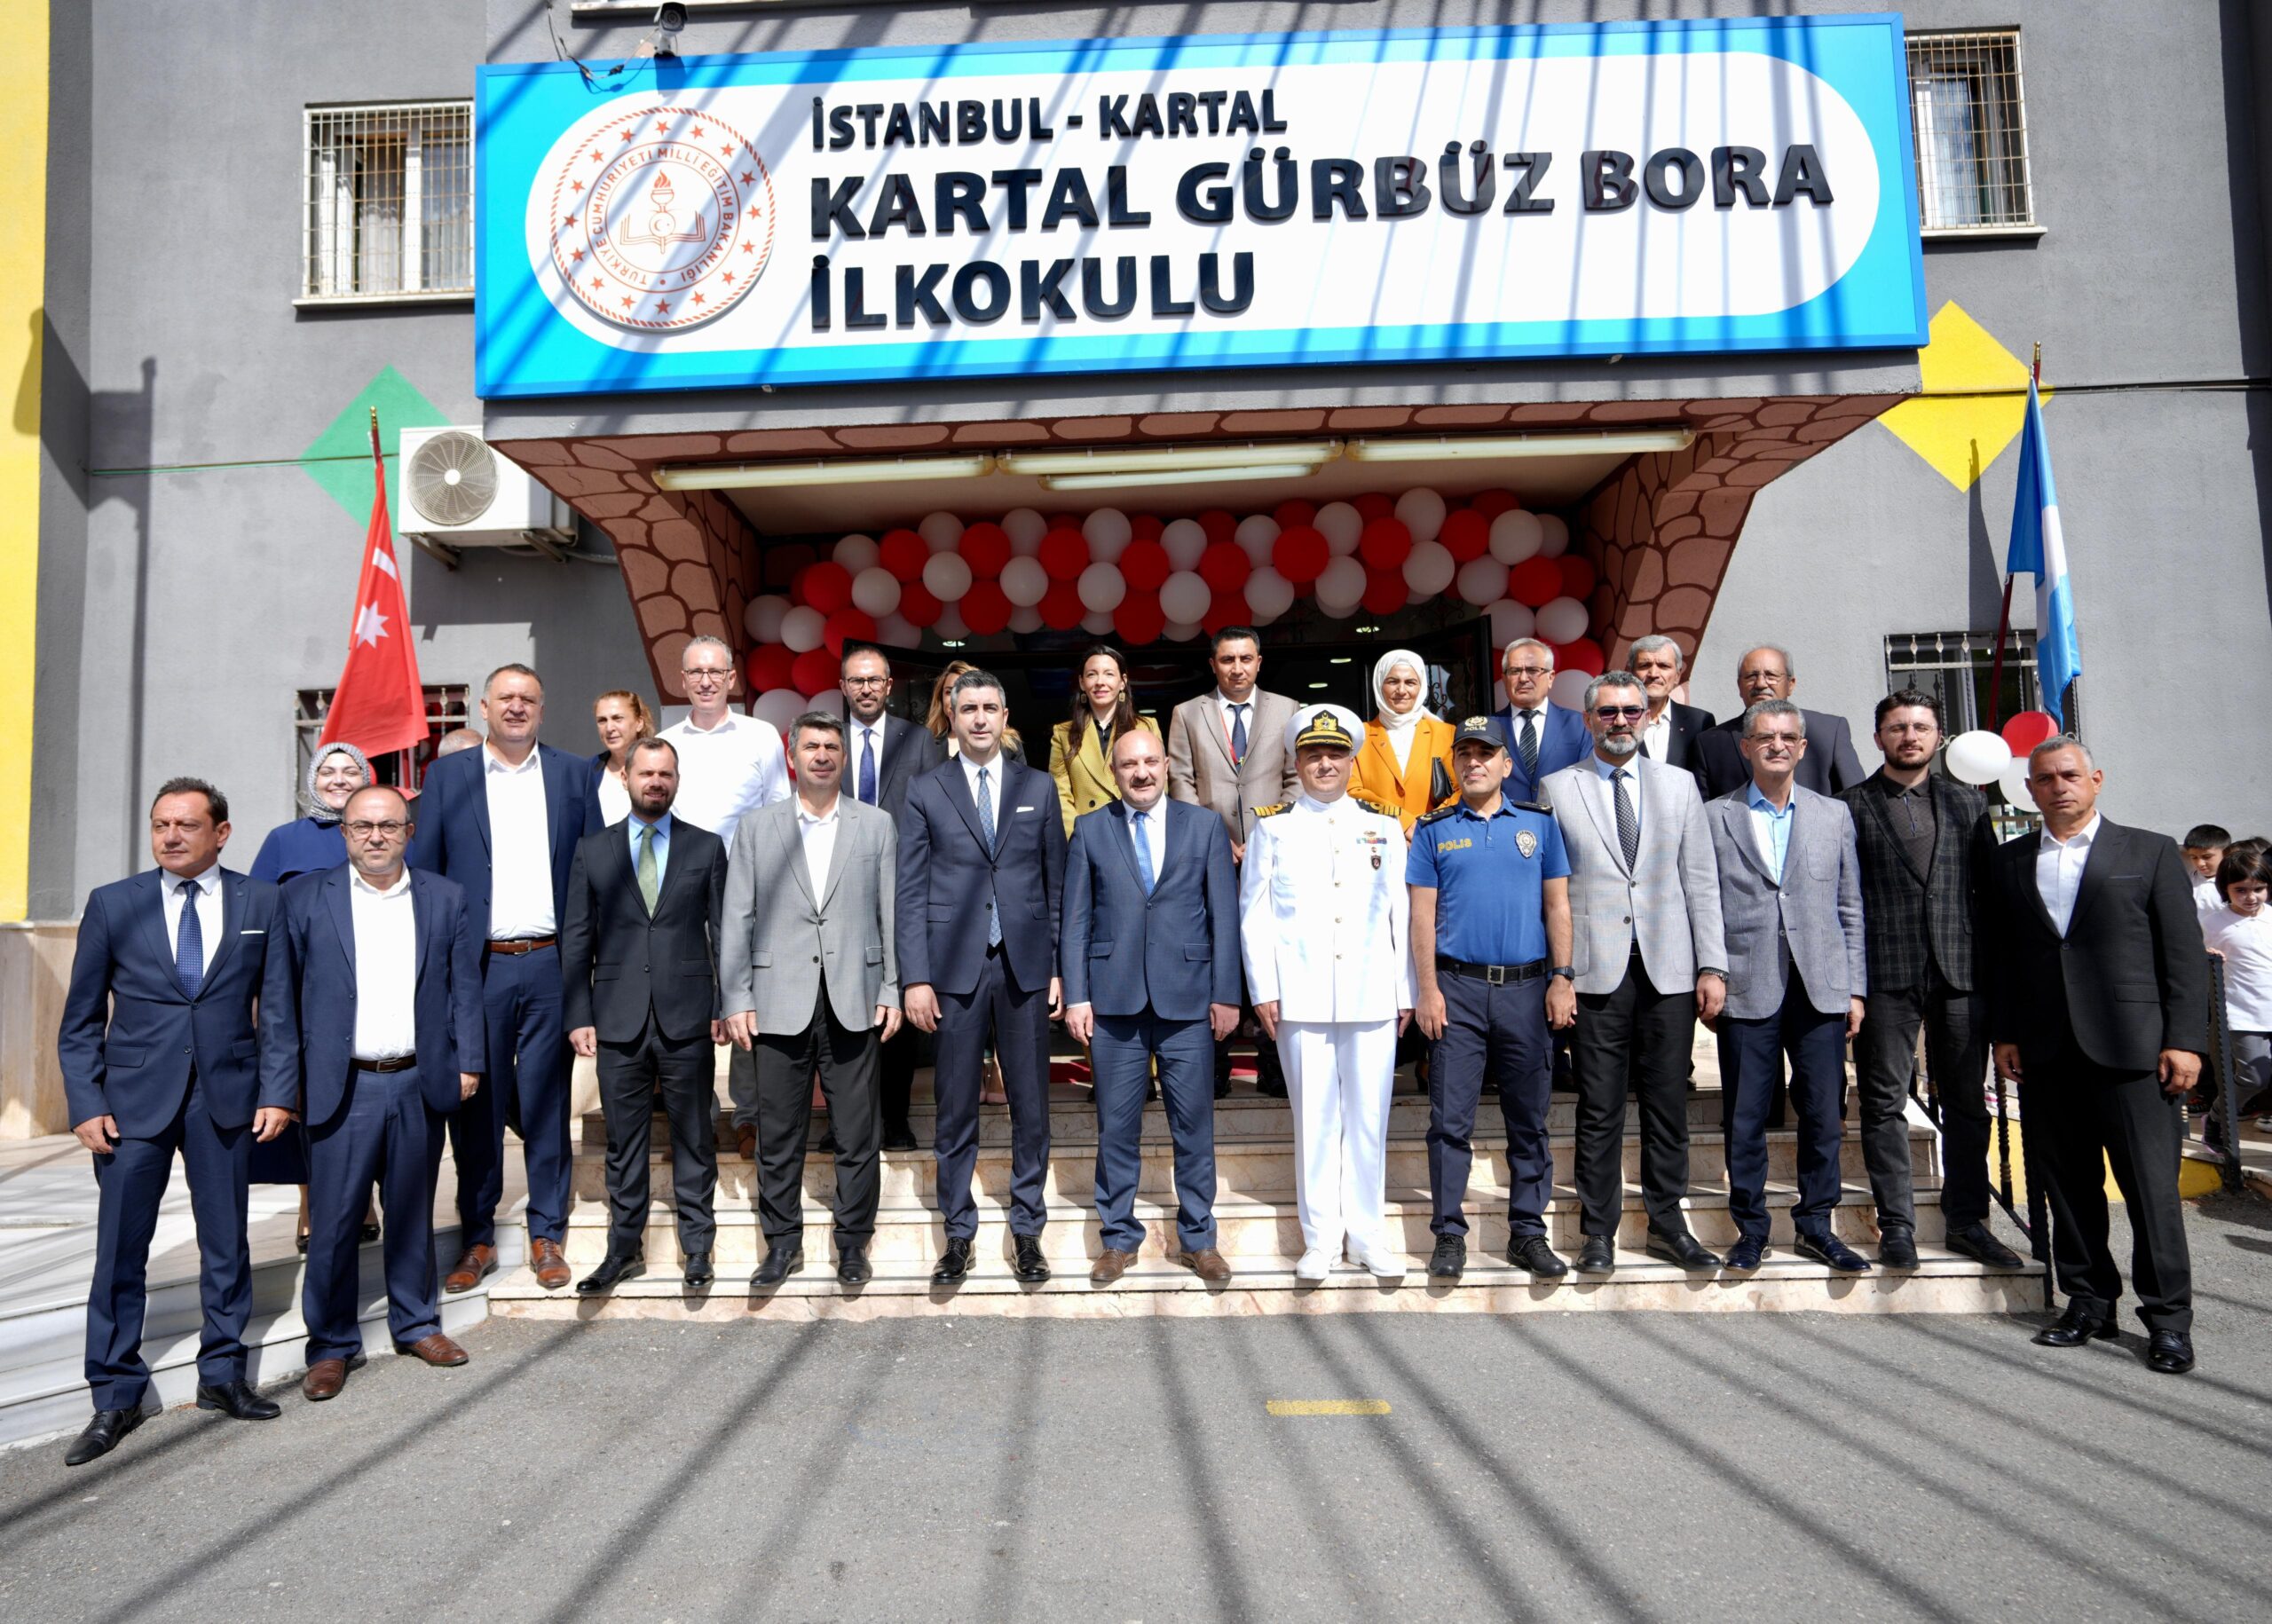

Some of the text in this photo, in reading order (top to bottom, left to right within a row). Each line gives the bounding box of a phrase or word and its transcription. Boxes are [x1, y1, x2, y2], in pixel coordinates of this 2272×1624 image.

[811, 90, 1288, 150] İSTANBUL - KARTAL
[811, 139, 1834, 240] KARTAL GÜRBÜZ BORA
[811, 252, 1255, 330] İLKOKULU
